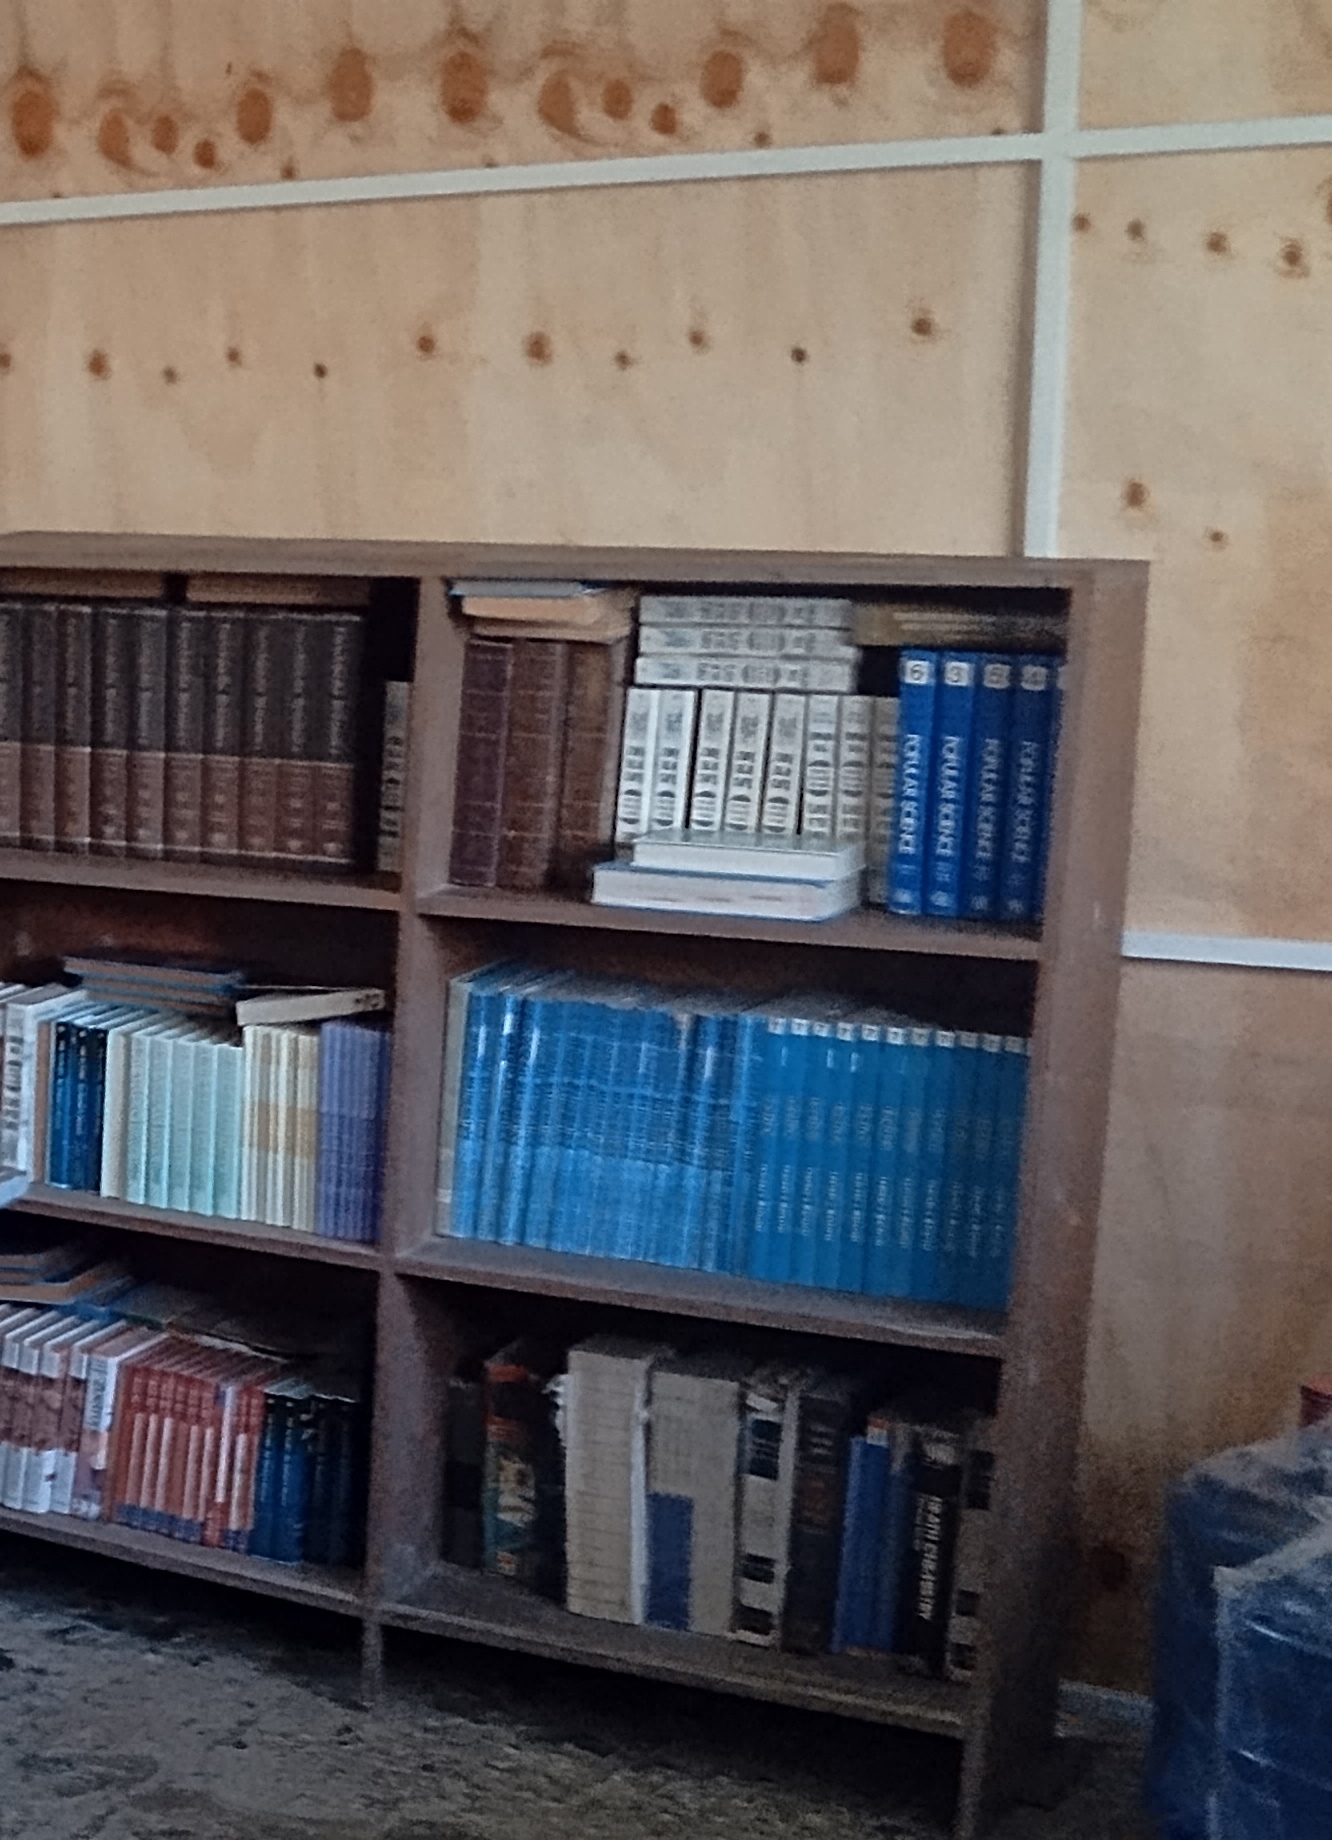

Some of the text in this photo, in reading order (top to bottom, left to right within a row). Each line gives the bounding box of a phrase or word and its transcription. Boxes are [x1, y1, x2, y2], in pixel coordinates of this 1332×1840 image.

[909, 663, 924, 681] 6
[899, 734, 921, 855] POPULAR SCIENCE
[937, 736, 960, 857] POPULAR SCIENCE
